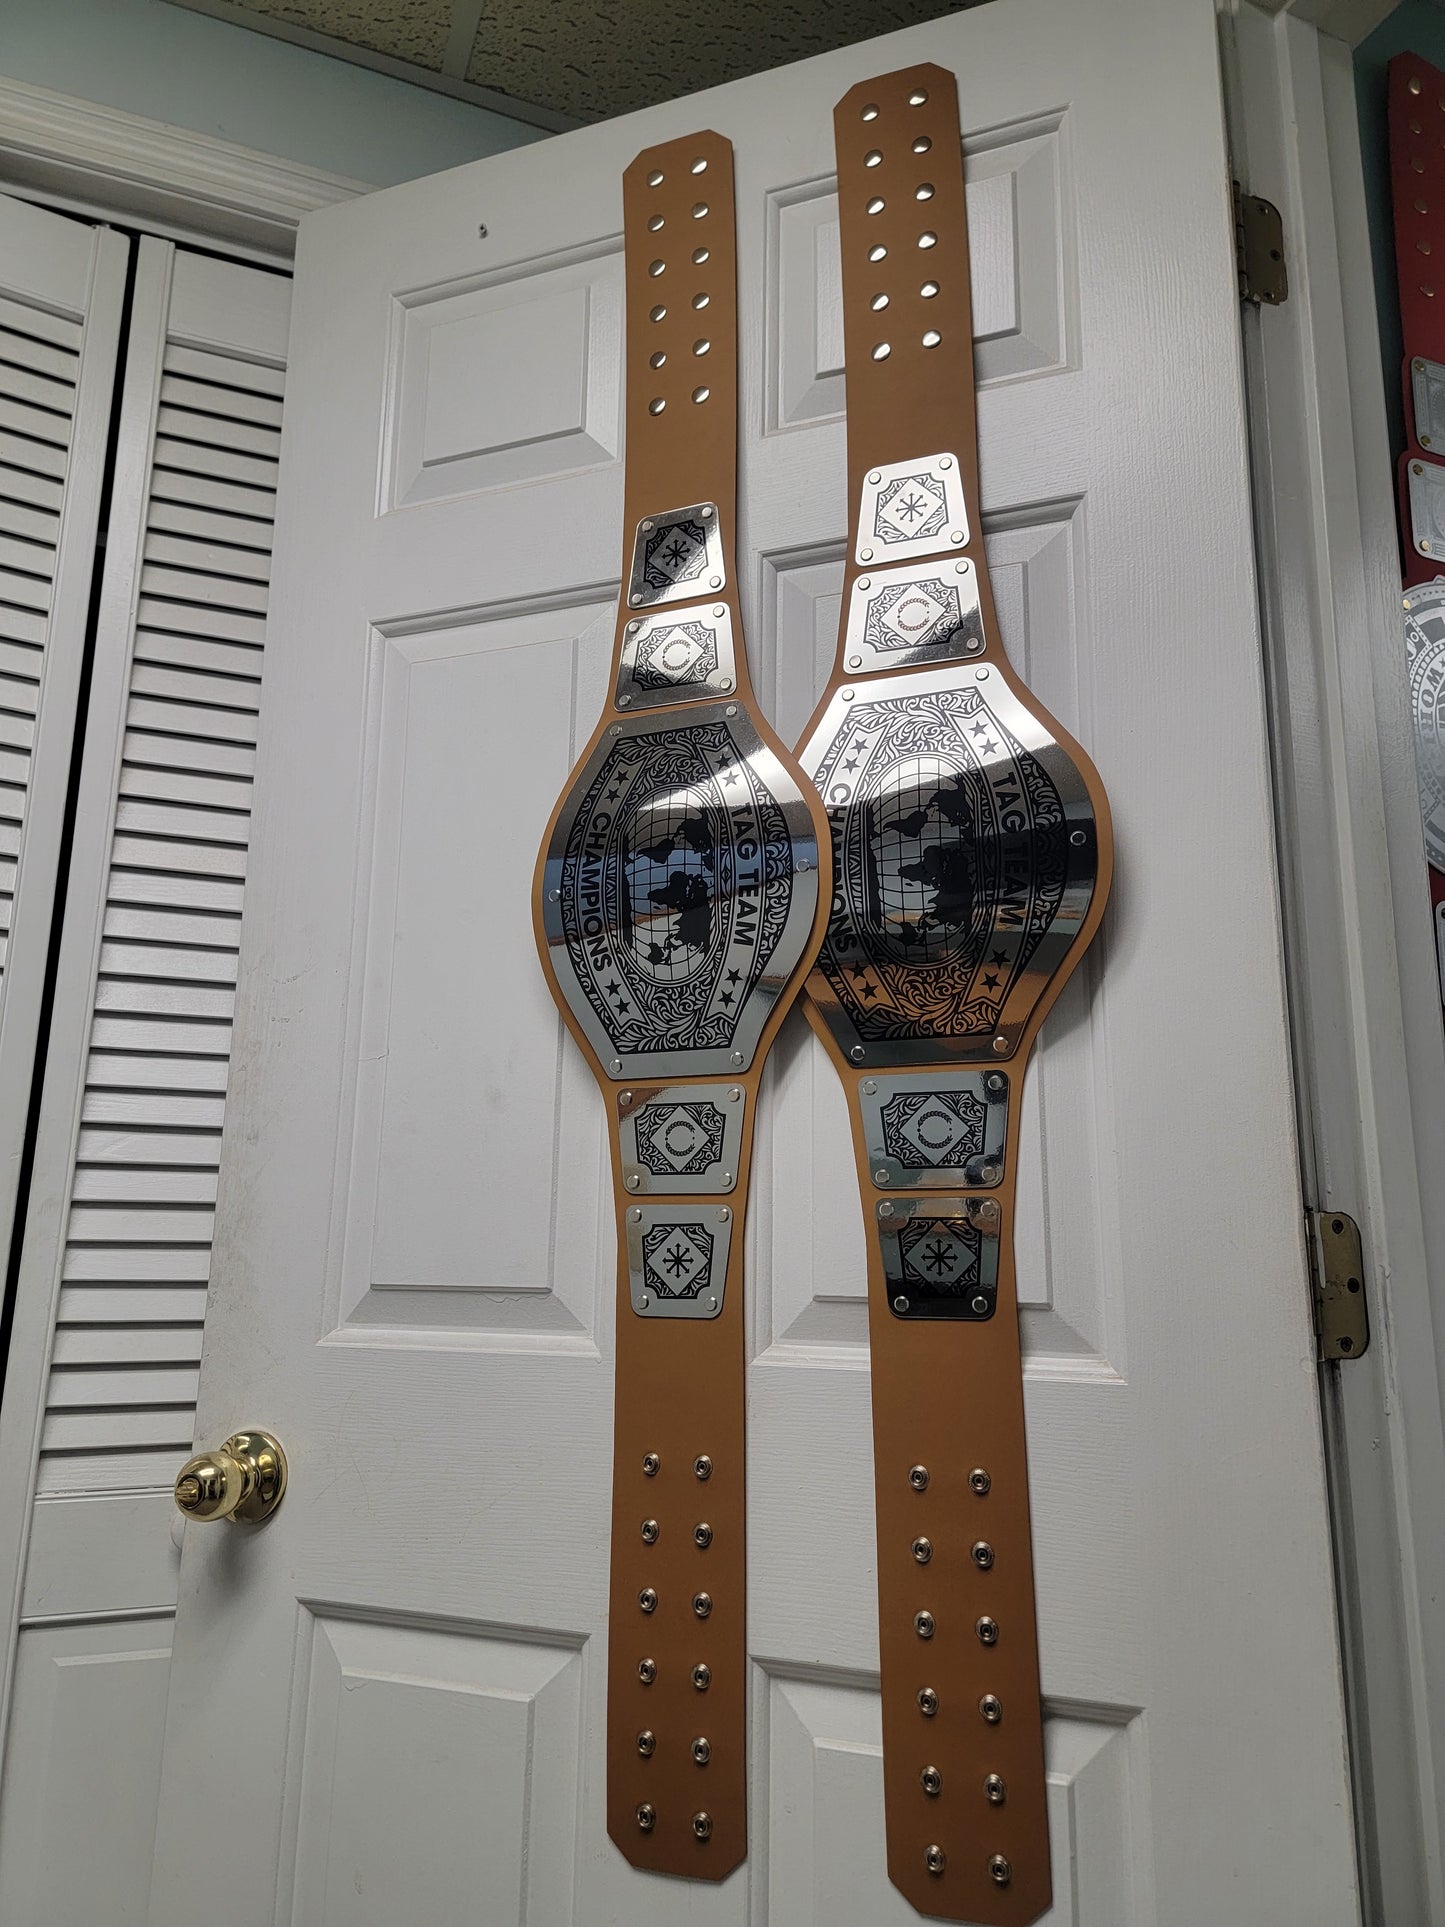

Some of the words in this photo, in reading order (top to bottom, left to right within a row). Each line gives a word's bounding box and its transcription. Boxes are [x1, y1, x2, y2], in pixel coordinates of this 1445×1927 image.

[731, 802, 758, 860] TAG
[992, 771, 1026, 833] TAG
[581, 812, 612, 972] CHAMPIONS
[733, 868, 759, 946] TEAM
[998, 841, 1029, 925] TEAM
